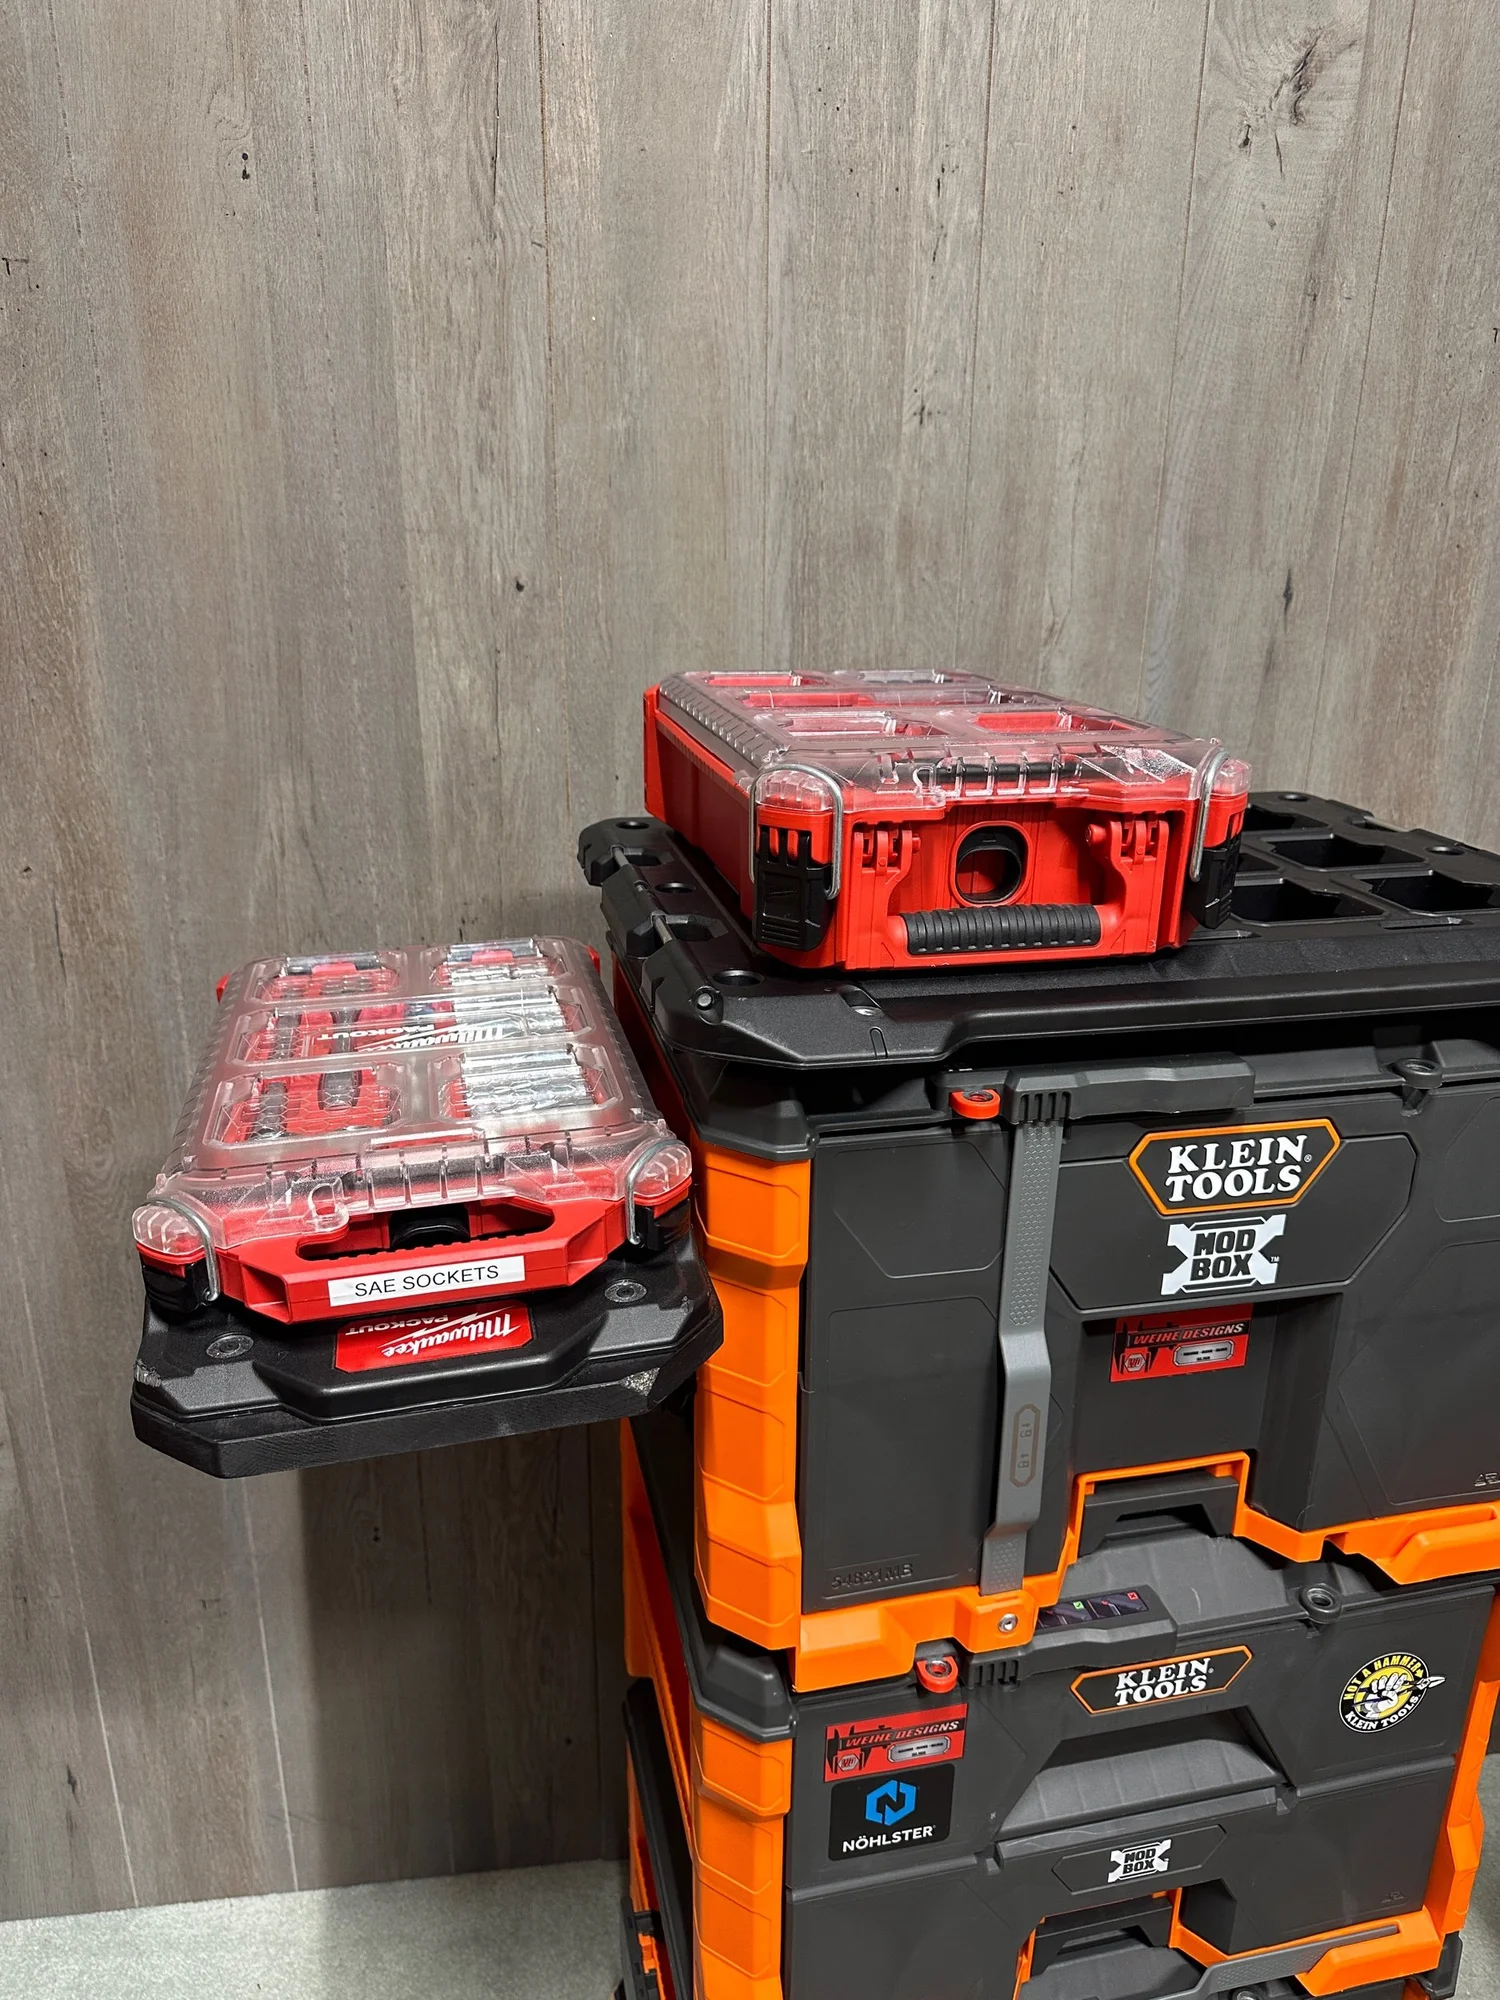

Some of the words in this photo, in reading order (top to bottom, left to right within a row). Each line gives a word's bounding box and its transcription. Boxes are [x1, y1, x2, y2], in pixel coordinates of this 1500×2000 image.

[1165, 1165, 1302, 1202] TOOLS
[1192, 1228, 1257, 1257] MOD
[355, 1278, 397, 1297] SAE
[402, 1265, 499, 1290] SOCKETS
[1189, 1252, 1254, 1282] BOX
[345, 1314, 449, 1336] PACKOUT
[381, 1313, 521, 1358] Milwaukee
[1133, 1331, 1179, 1345] WEIHE
[1181, 1323, 1245, 1340] DESIGNS
[1361, 1668, 1372, 1678] A
[1373, 1655, 1422, 1673] HAMMER
[1114, 1675, 1207, 1706] TOOLS
[1345, 1711, 1379, 1730] KLEIN
[1380, 1695, 1419, 1727] TOOLS
[846, 1732, 893, 1747] WEIHE
[895, 1720, 960, 1739] DESIGNS
[842, 1826, 933, 1853] NÖHLSTER
[1122, 1858, 1155, 1875] BOX
[1124, 1848, 1157, 1863] MOD
